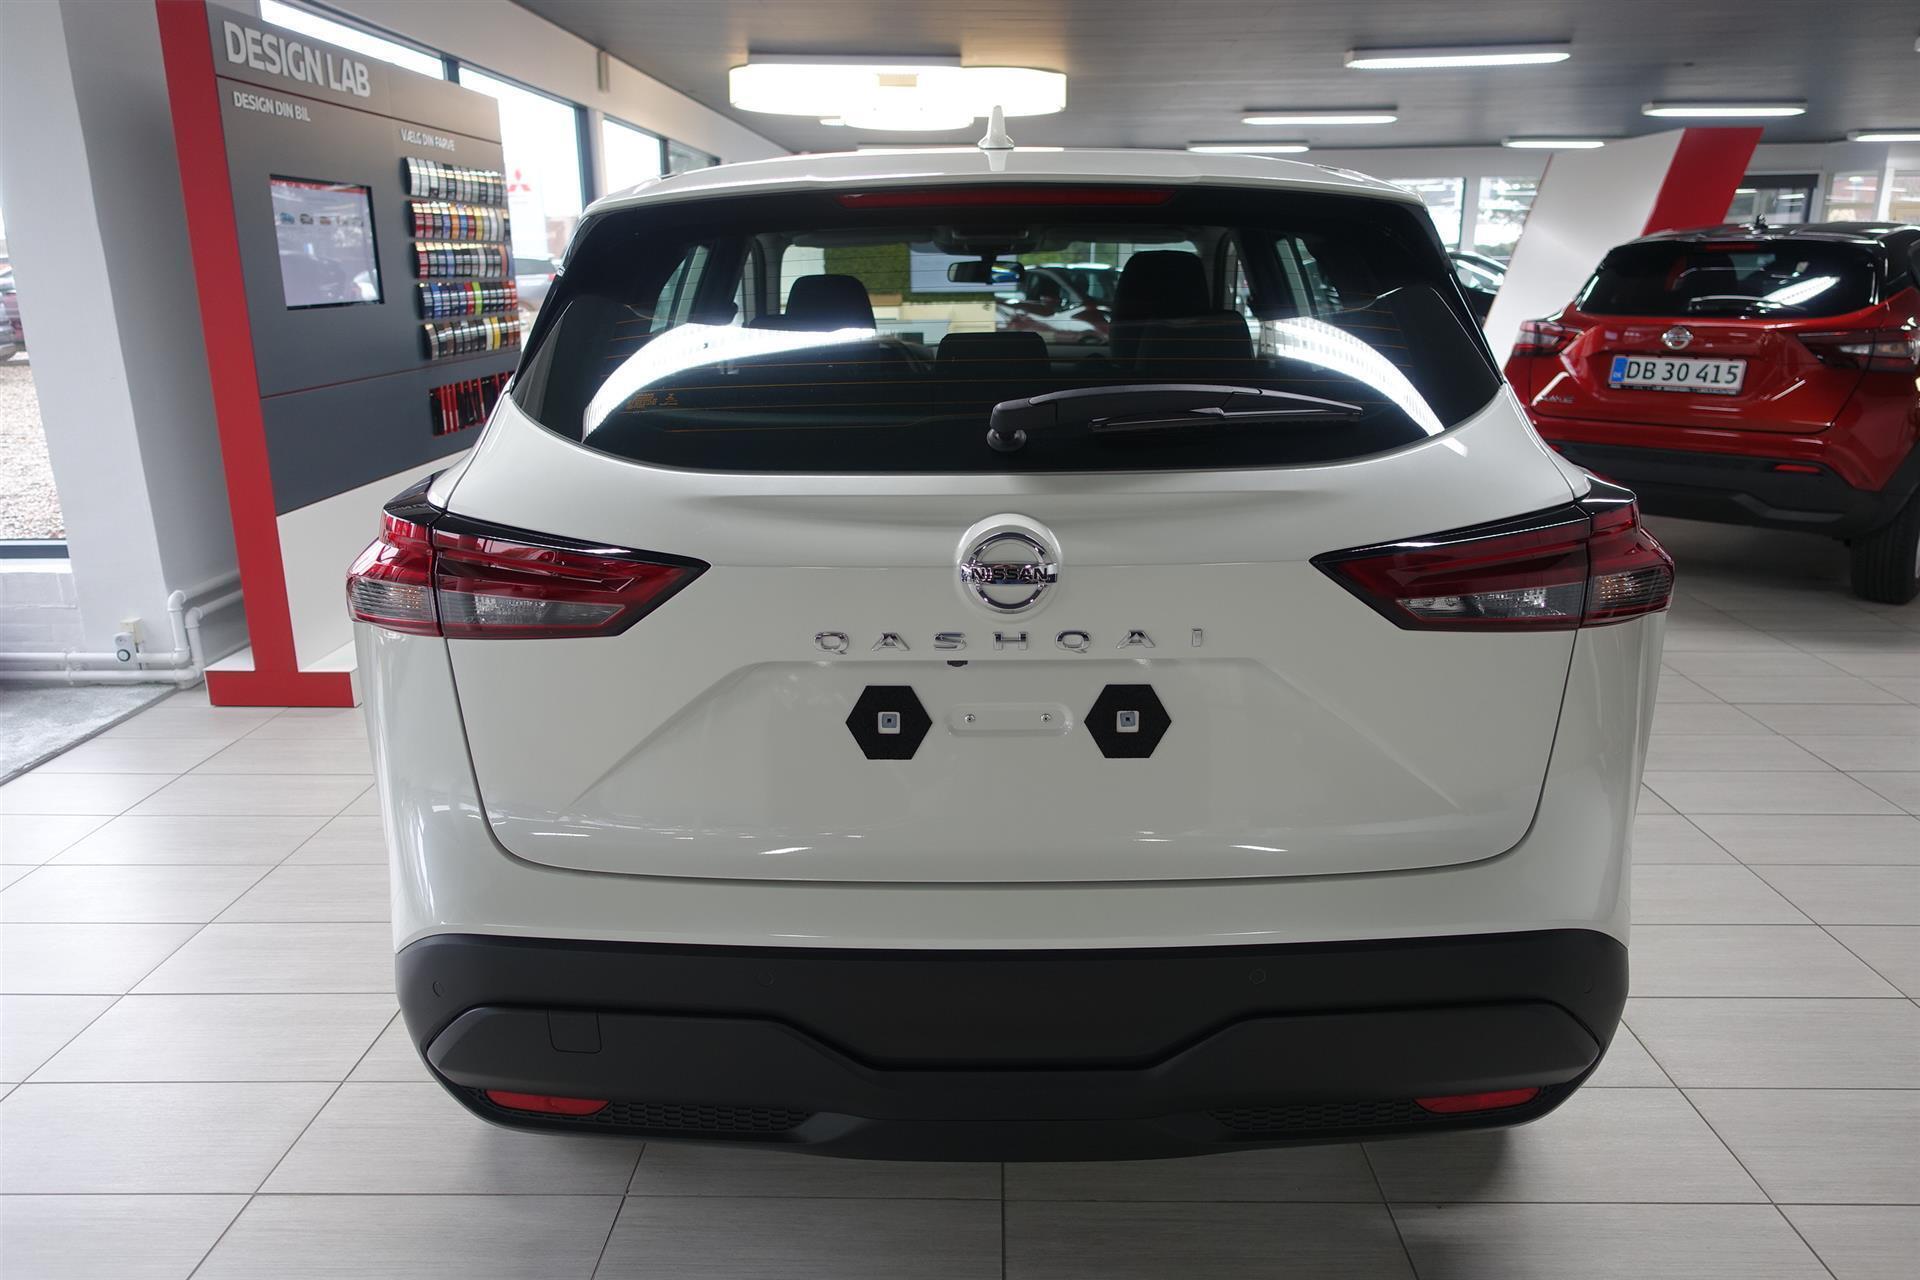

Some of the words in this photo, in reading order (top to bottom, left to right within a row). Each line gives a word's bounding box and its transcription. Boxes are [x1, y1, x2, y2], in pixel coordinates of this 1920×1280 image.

[223, 20, 324, 86] DESIGN
[326, 53, 371, 97] LAB
[233, 91, 274, 114] DESIGN
[275, 101, 294, 118] DIN
[294, 105, 311, 122] BIL
[1627, 361, 1656, 380] DB
[1661, 362, 1690, 382] 30
[1695, 364, 1740, 384] 415
[971, 567, 1048, 581] NISSAN
[813, 628, 1204, 655] QASHQAI
